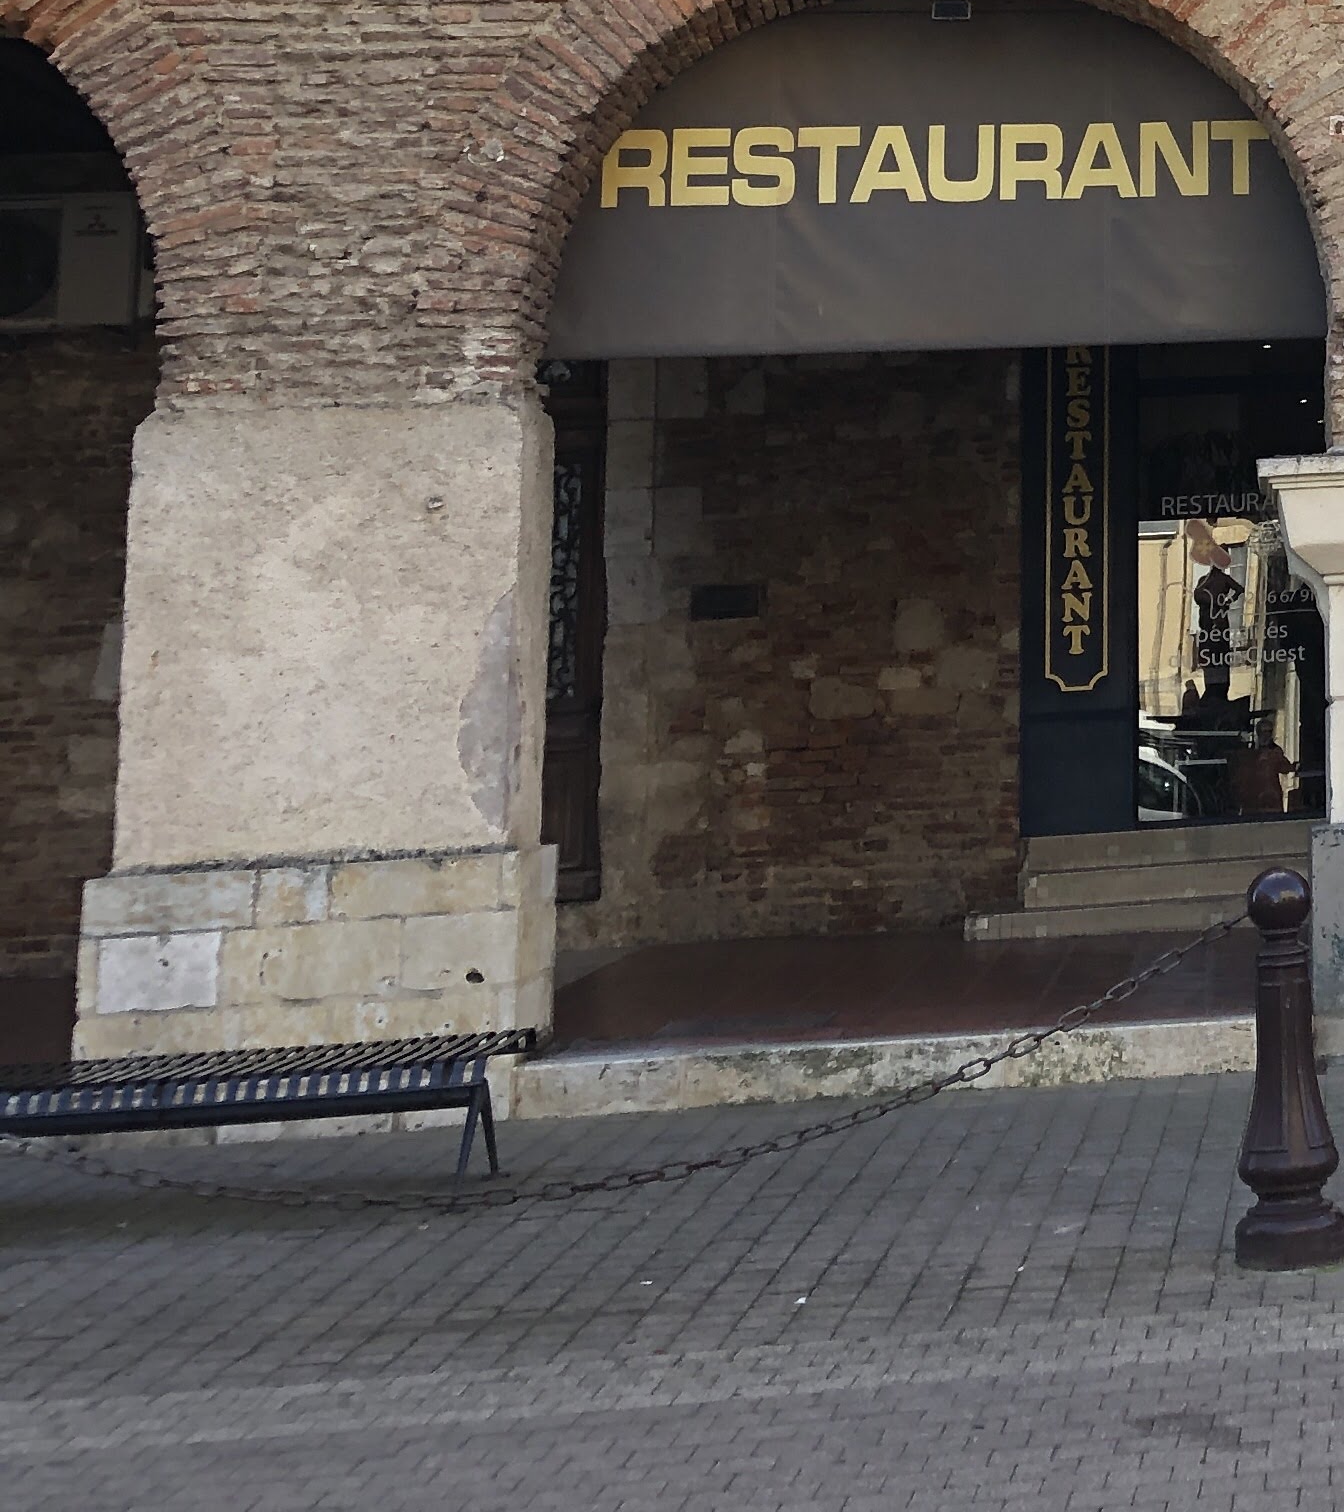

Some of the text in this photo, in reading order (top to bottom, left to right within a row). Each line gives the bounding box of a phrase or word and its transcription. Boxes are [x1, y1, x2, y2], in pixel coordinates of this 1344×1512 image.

[600, 119, 1271, 209] RESTAURANT
[1061, 345, 1095, 655] RESTAURANT
[1160, 491, 1278, 517] RESTAURA
